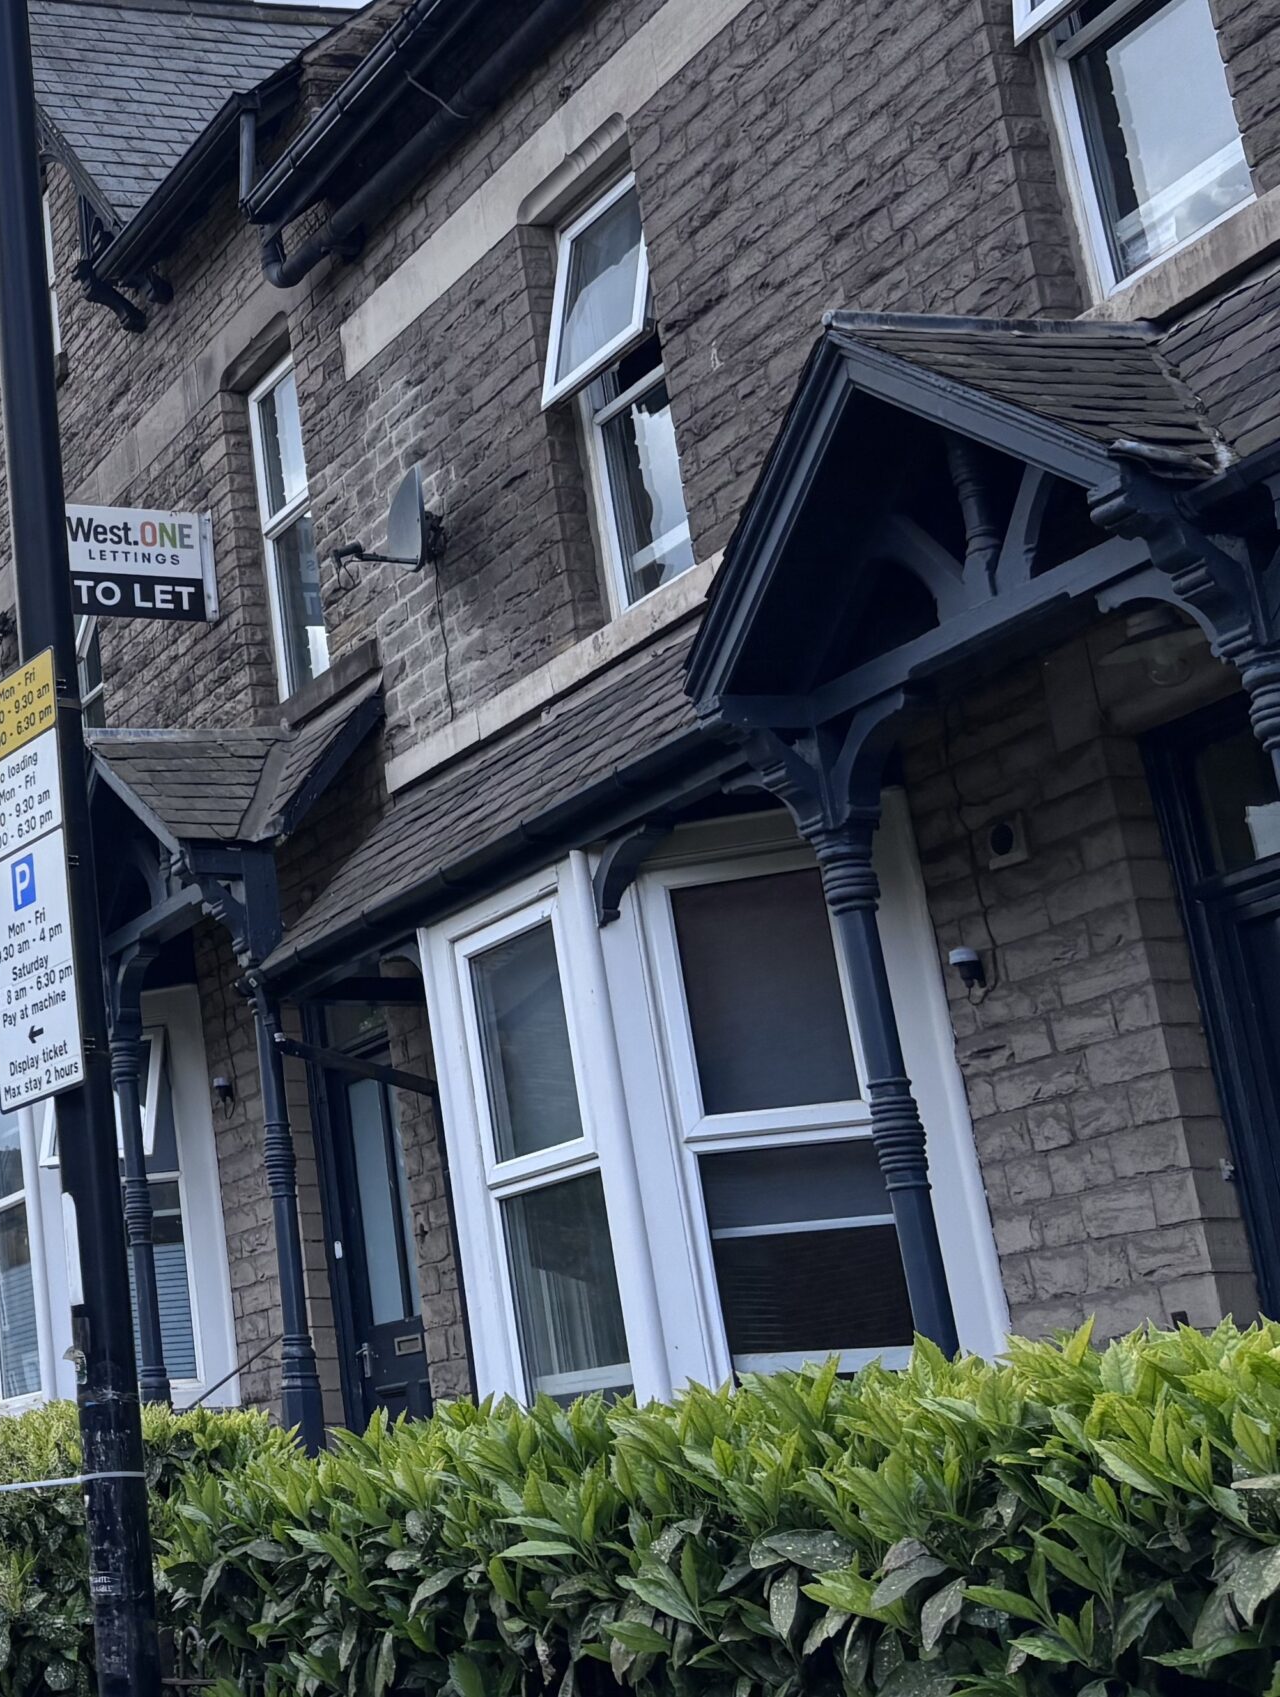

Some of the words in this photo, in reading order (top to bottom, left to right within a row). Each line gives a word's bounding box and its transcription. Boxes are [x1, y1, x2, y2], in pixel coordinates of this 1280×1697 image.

[66, 516, 194, 549] West.ONE
[89, 549, 180, 565] LETTINGS
[74, 580, 121, 606] TO
[134, 584, 195, 610] LET
[24, 667, 36, 686] Fri
[14, 690, 34, 714] 9.30
[36, 683, 50, 699] am
[16, 712, 36, 736] 6.30
[38, 704, 52, 724] pm
[8, 752, 38, 779] loading
[24, 771, 36, 790] Fri
[15, 795, 34, 818] 9.30
[38, 789, 50, 805] am
[18, 816, 36, 838] 6.30
[40, 810, 53, 828] pm
[15, 863, 30, 905] P
[8, 922, 26, 939] Mon
[34, 906, 46, 926] Fri
[18, 939, 30, 954] am
[40, 928, 46, 942] 4
[48, 922, 62, 942] pm
[12, 954, 48, 982] Saturday
[6, 990, 12, 1005] 8
[14, 986, 27, 1001] am
[36, 969, 56, 991] 6.30
[58, 964, 72, 984] pm
[2, 1012, 17, 1028] Pay
[20, 1004, 29, 1020] at
[32, 990, 66, 1015] machine
[10, 1054, 39, 1076] Display
[42, 1040, 68, 1063] ticket
[4, 1085, 22, 1102] Max
[24, 1076, 42, 1094] stay
[45, 1068, 52, 1084] 2
[54, 1062, 78, 1081] hours
